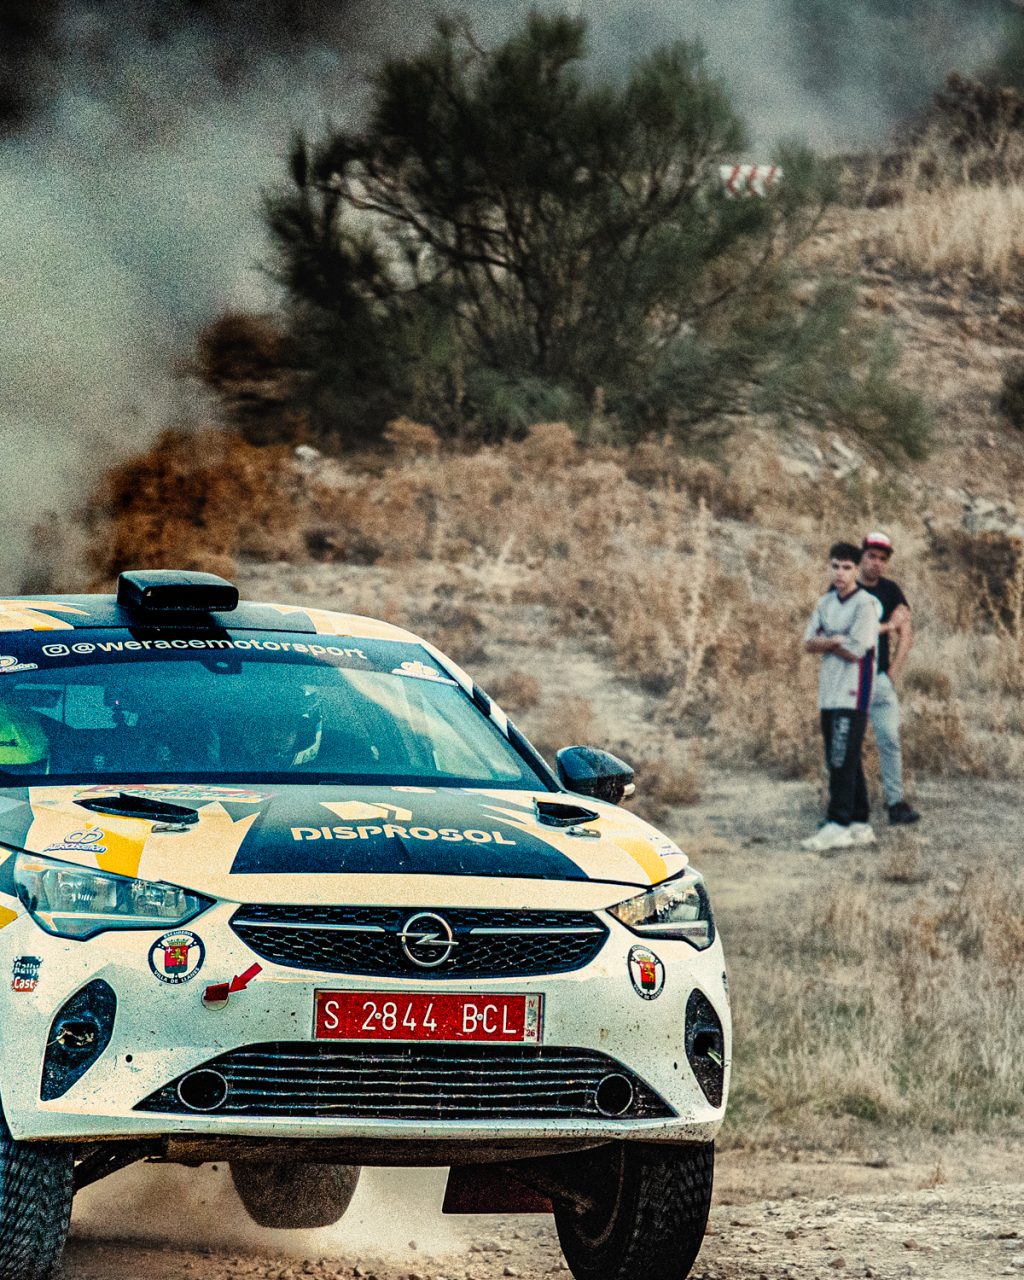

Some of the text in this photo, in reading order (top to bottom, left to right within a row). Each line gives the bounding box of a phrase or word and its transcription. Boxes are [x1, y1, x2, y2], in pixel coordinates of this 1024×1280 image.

[71, 639, 368, 661] @weracemotorsport
[290, 824, 516, 846] DISPROSOL
[14, 961, 39, 977] Rally
[14, 976, 37, 990] Cast
[324, 1000, 518, 1035] S 2844 BCL
